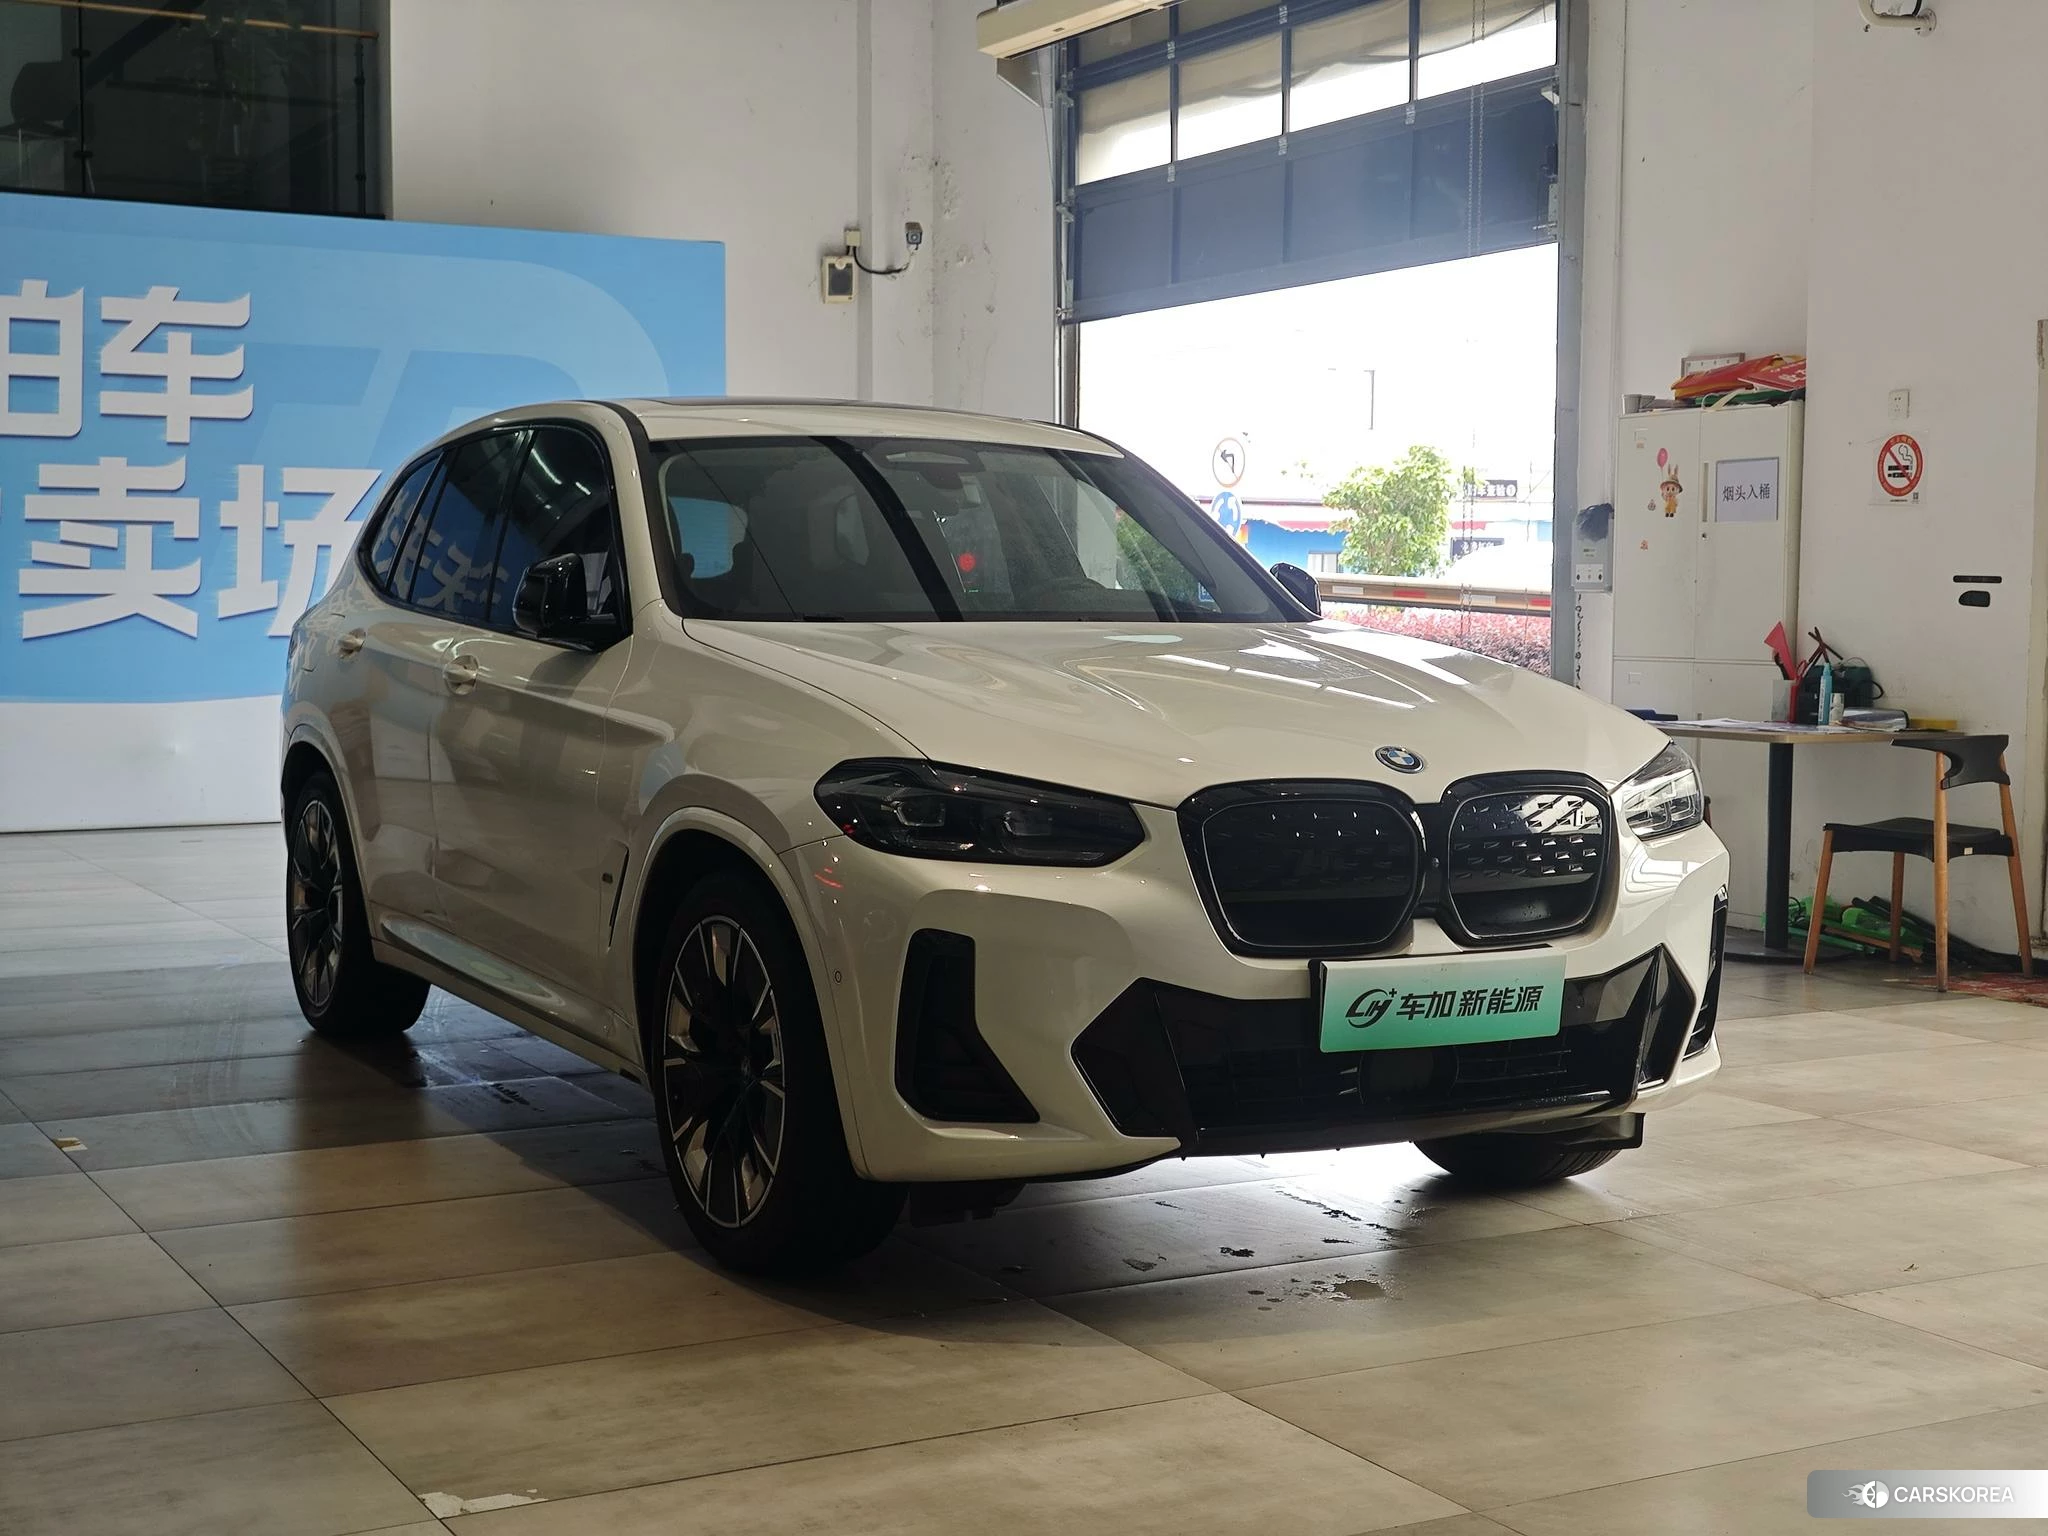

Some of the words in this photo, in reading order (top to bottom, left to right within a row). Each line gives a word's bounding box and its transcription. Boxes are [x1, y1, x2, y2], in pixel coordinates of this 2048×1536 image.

[1722, 483, 1770, 502] 烟头入桶
[18, 455, 382, 640] 卖场
[1396, 985, 1544, 1020] 车加新能源
